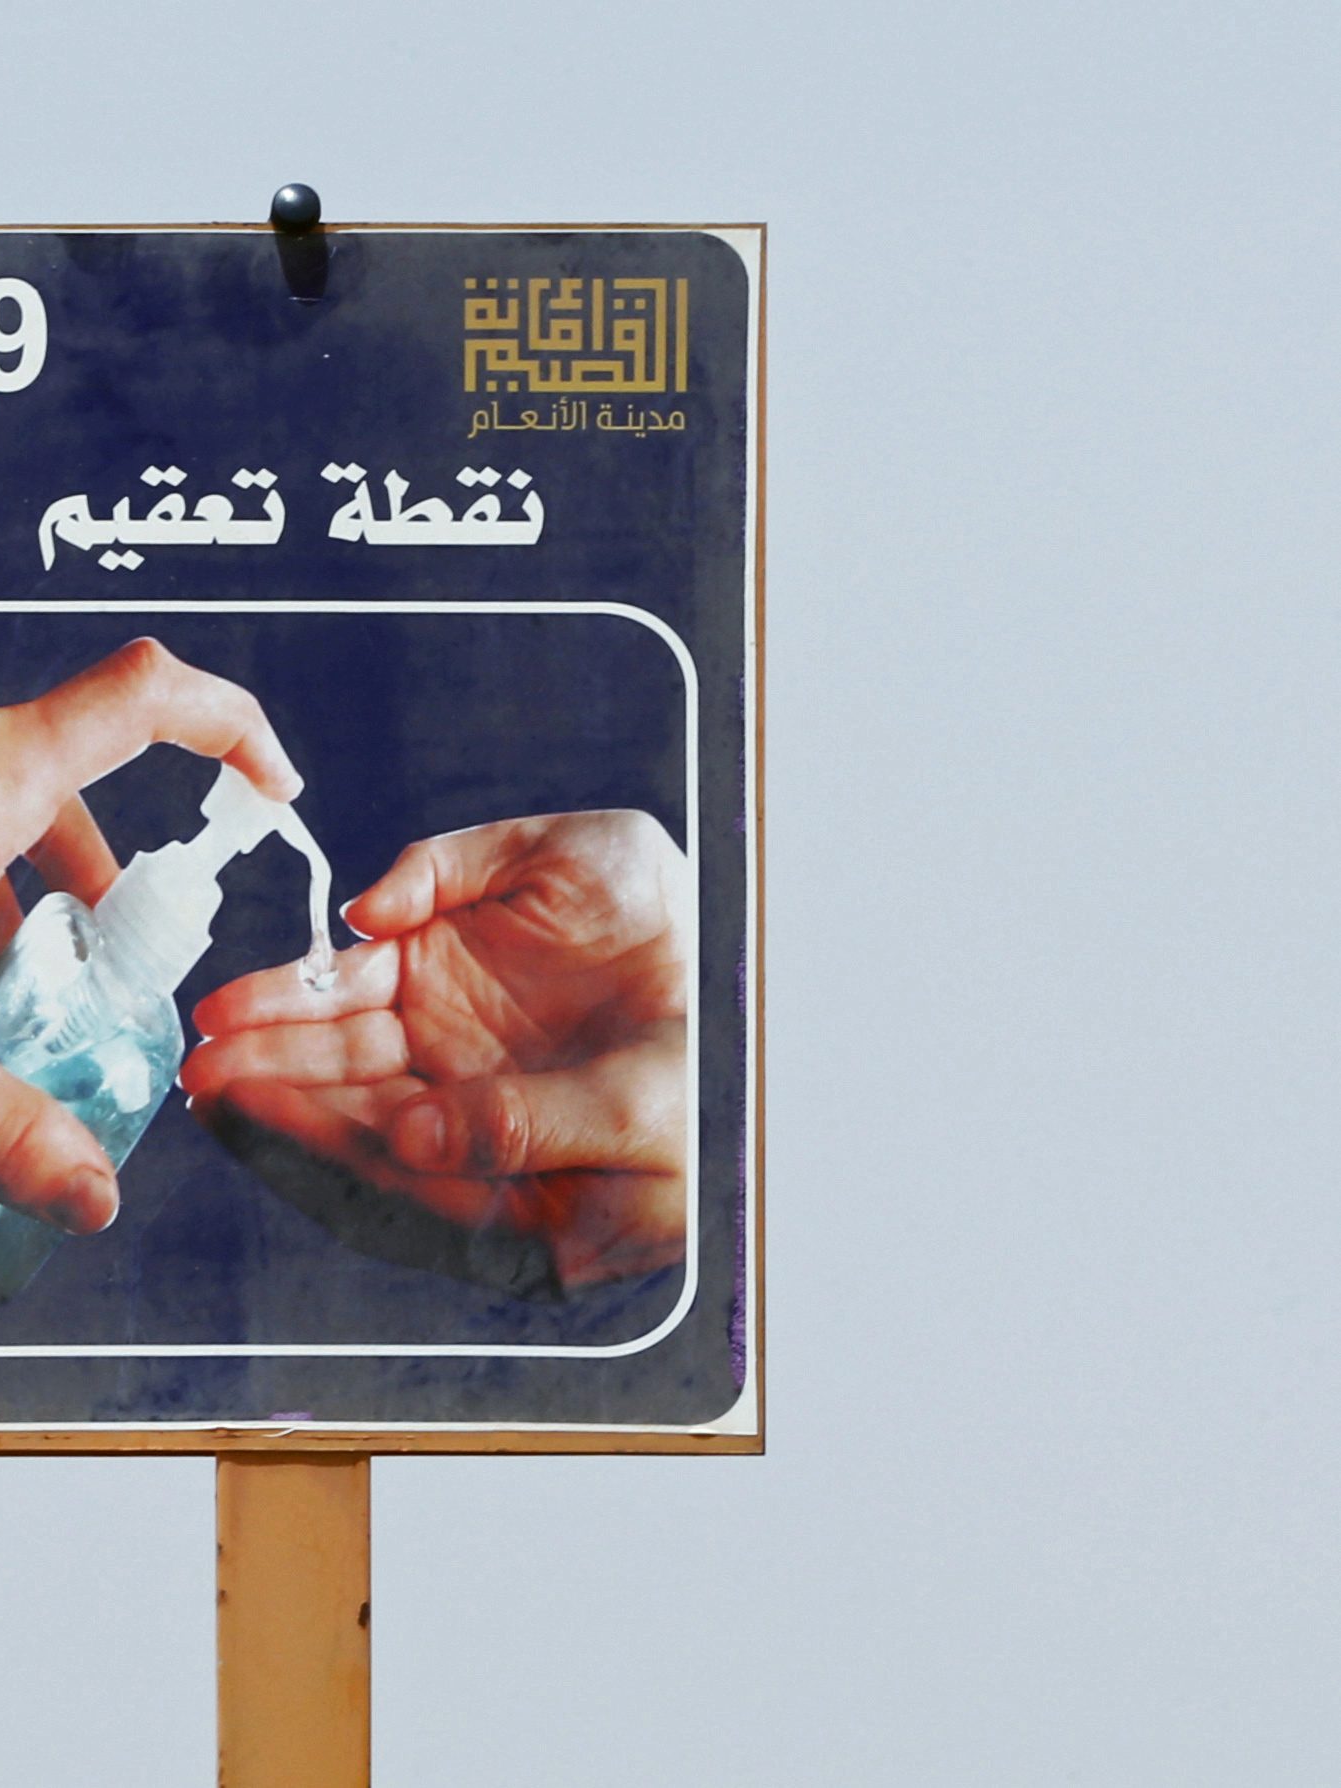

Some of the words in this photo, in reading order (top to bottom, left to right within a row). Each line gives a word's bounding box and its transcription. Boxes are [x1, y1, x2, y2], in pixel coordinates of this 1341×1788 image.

[467, 395, 589, 439] الأنعام
[595, 402, 687, 438] مدينة
[38, 465, 286, 571] تعقيم
[320, 462, 545, 546] نقطة
